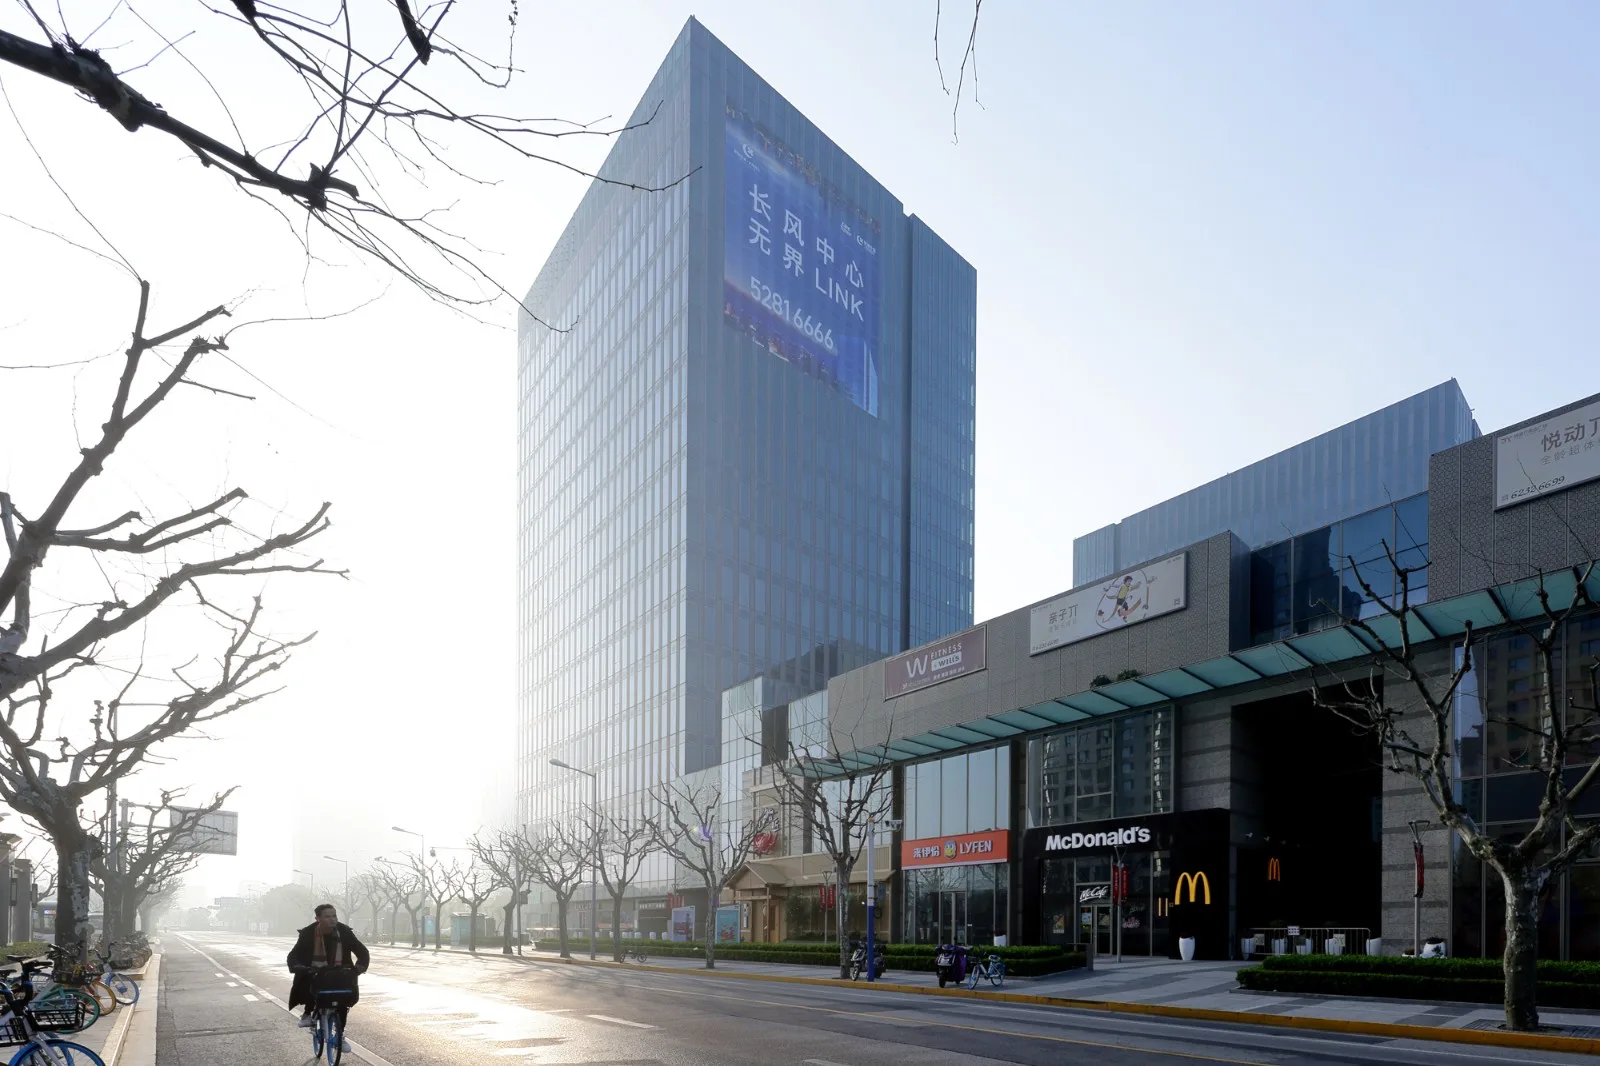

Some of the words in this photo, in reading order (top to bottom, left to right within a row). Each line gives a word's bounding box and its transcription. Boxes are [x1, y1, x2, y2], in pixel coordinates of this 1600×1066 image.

[749, 184, 863, 288] 长风中心
[749, 217, 804, 277] 无界
[816, 268, 863, 322] LINK
[750, 276, 834, 350] 52816666
[1510, 475, 1565, 499] 62326699
[930, 643, 962, 660] FITNESS
[913, 845, 940, 859] 来伊份
[960, 840, 993, 854] LYFEN
[1045, 826, 1151, 851] McDonald's
